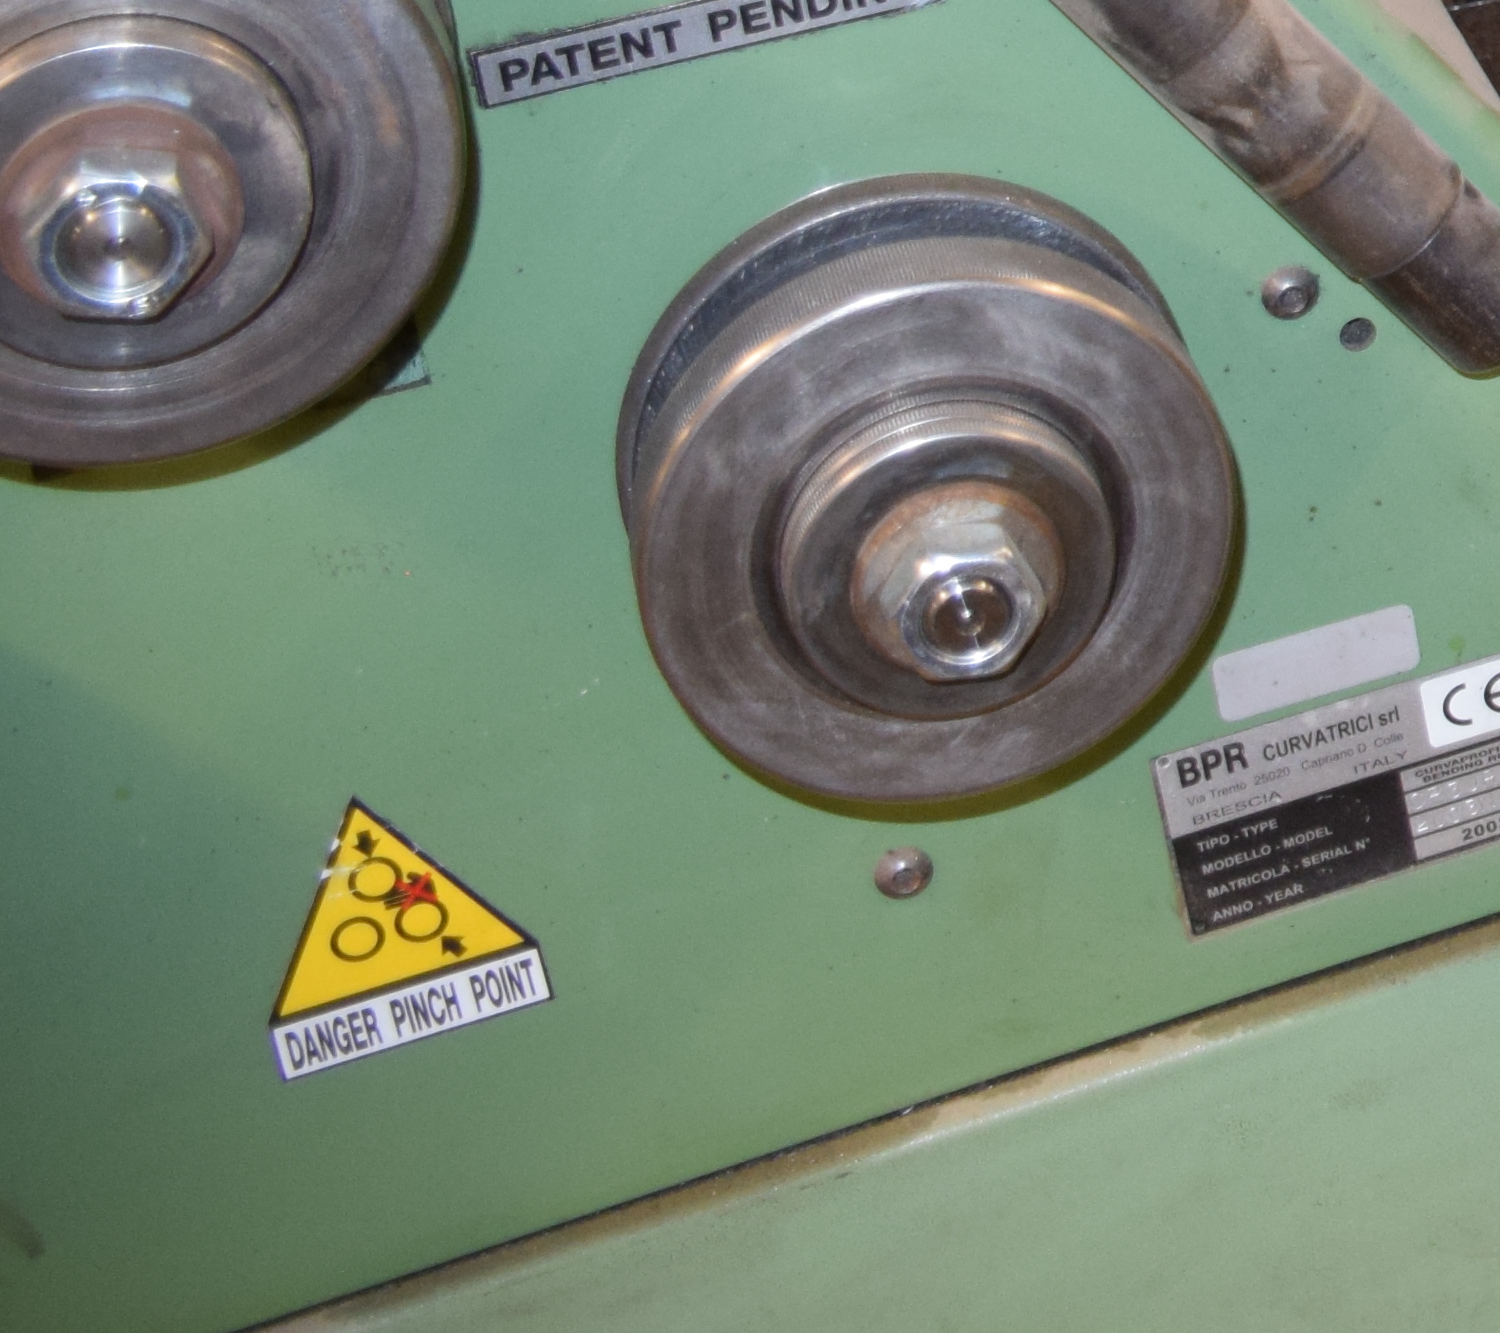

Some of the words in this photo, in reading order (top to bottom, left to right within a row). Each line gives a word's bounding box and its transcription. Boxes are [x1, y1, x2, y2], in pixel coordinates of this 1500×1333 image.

[499, 19, 682, 92] PATENT
[1176, 741, 1250, 789] BPR
[1263, 714, 1374, 762] CURVATRICI
[1378, 705, 1401, 727] srl
[1422, 759, 1484, 784] BENDING
[1187, 795, 1206, 807] Via
[1210, 782, 1247, 801] Trento
[1254, 766, 1291, 786] 25020
[1301, 748, 1355, 771] Capriano
[1192, 789, 1283, 826] BRESCIA
[1353, 749, 1409, 775] ITALY
[1196, 834, 1231, 853] TIPO
[1241, 818, 1279, 839] TYPE
[1201, 845, 1272, 875] MODELLO
[1282, 826, 1334, 850] MODEL
[1206, 864, 1291, 899] MATRICOLA
[1301, 845, 1353, 869] SERIAL
[1212, 900, 1254, 923] ANNO
[1264, 883, 1305, 906] YEAR
[285, 1006, 385, 1071] DANGER
[389, 981, 464, 1039] PINCH
[468, 957, 539, 1014] POINT
